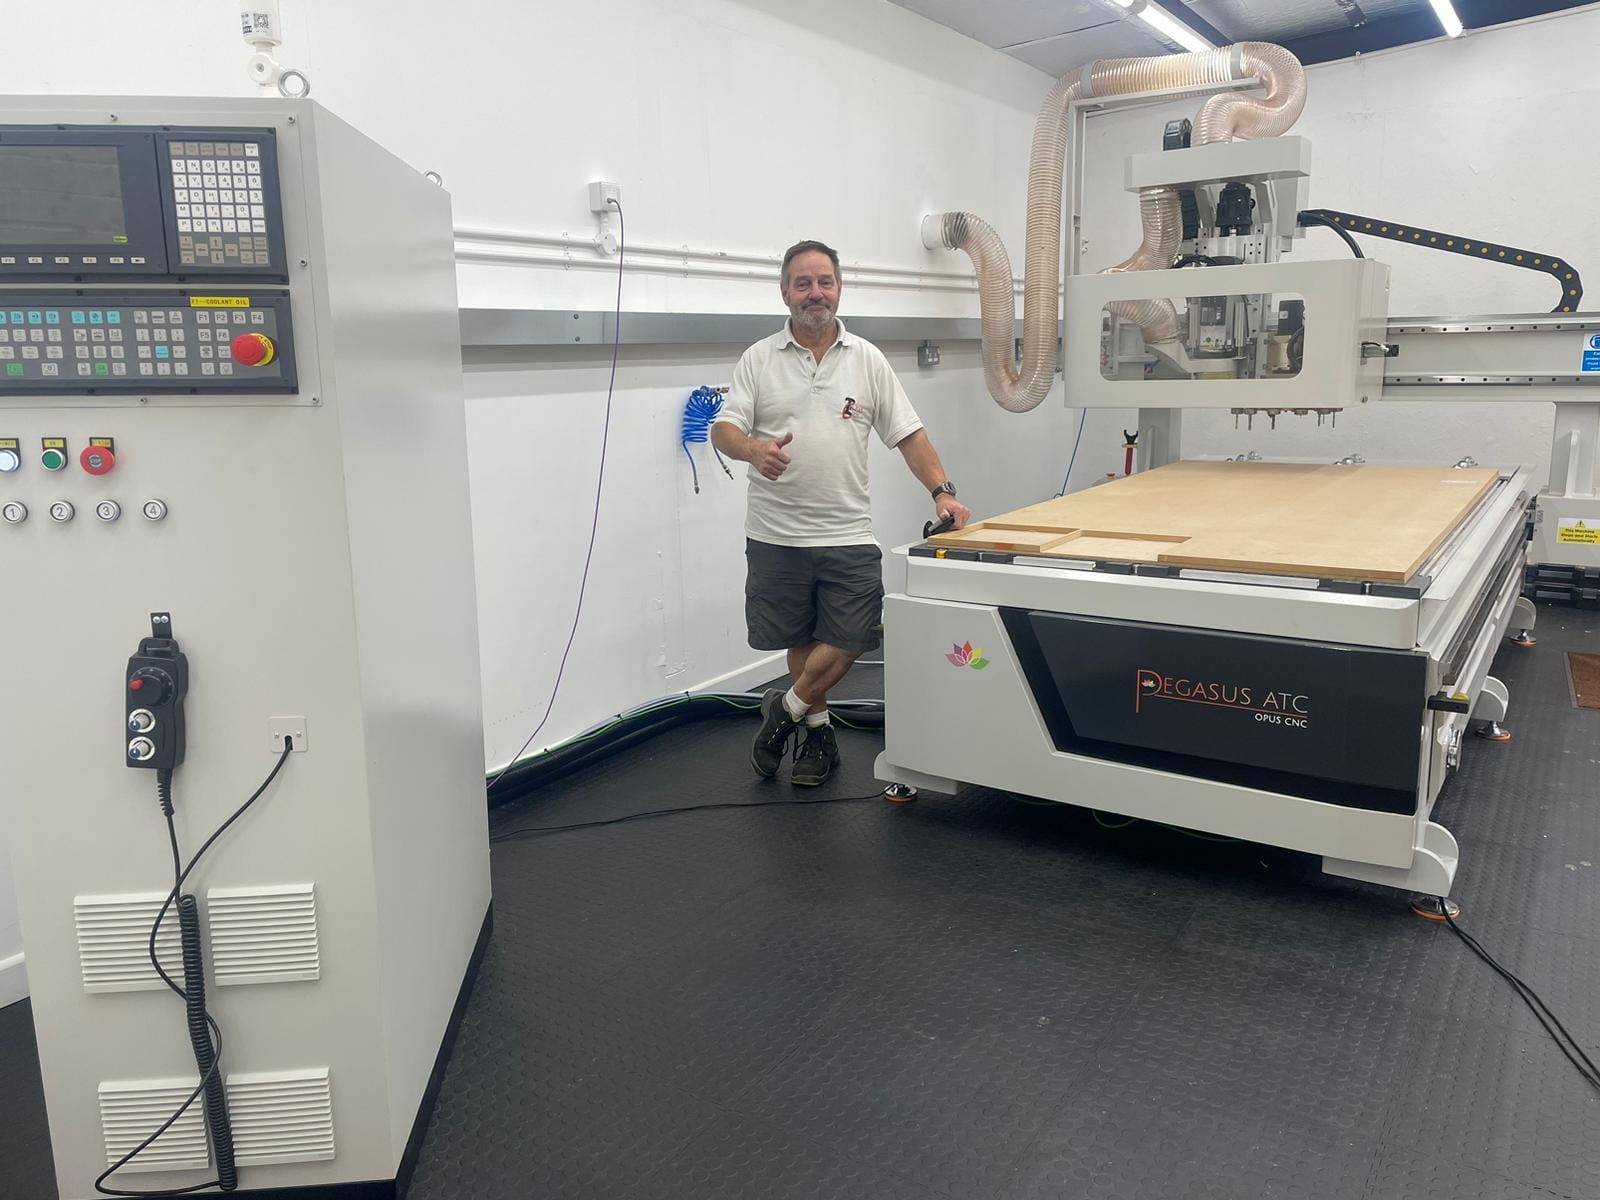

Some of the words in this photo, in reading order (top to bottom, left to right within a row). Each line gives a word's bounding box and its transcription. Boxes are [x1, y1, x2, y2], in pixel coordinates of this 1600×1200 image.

[56, 507, 64, 517] 2
[103, 506, 110, 516] 3
[149, 505, 157, 515] 4
[1135, 668, 1252, 713] PEGASUS
[1262, 692, 1310, 714] ATC
[1254, 712, 1281, 725] OPUS
[1284, 717, 1308, 729] CNC
